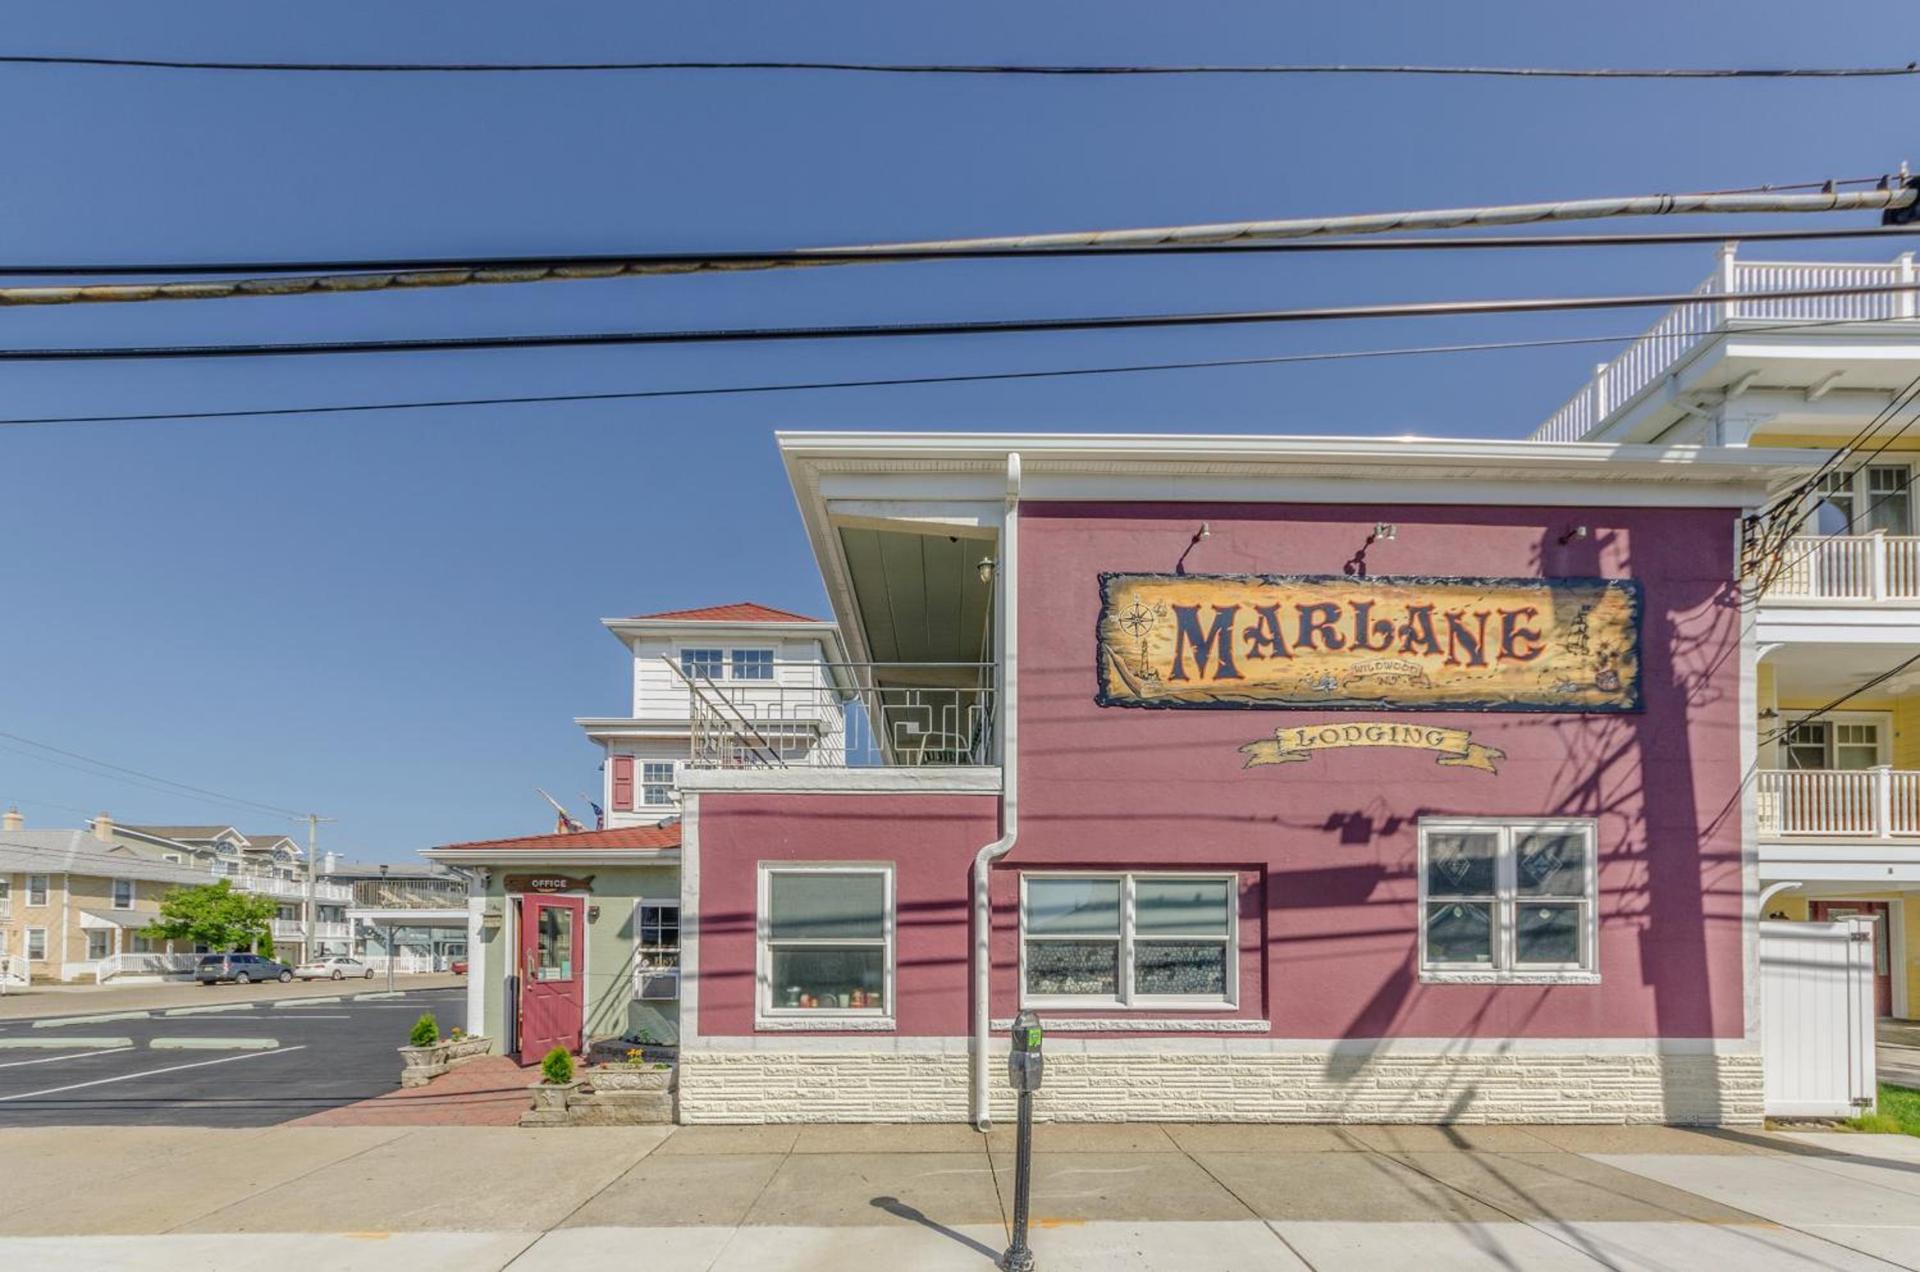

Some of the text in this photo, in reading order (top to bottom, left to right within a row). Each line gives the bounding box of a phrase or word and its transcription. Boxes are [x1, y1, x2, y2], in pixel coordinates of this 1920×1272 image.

[1168, 600, 1546, 681] MARLANE
[1354, 661, 1418, 674] WILDWOOD
[1295, 725, 1445, 748] LODGING
[531, 879, 567, 888] OFFICE
